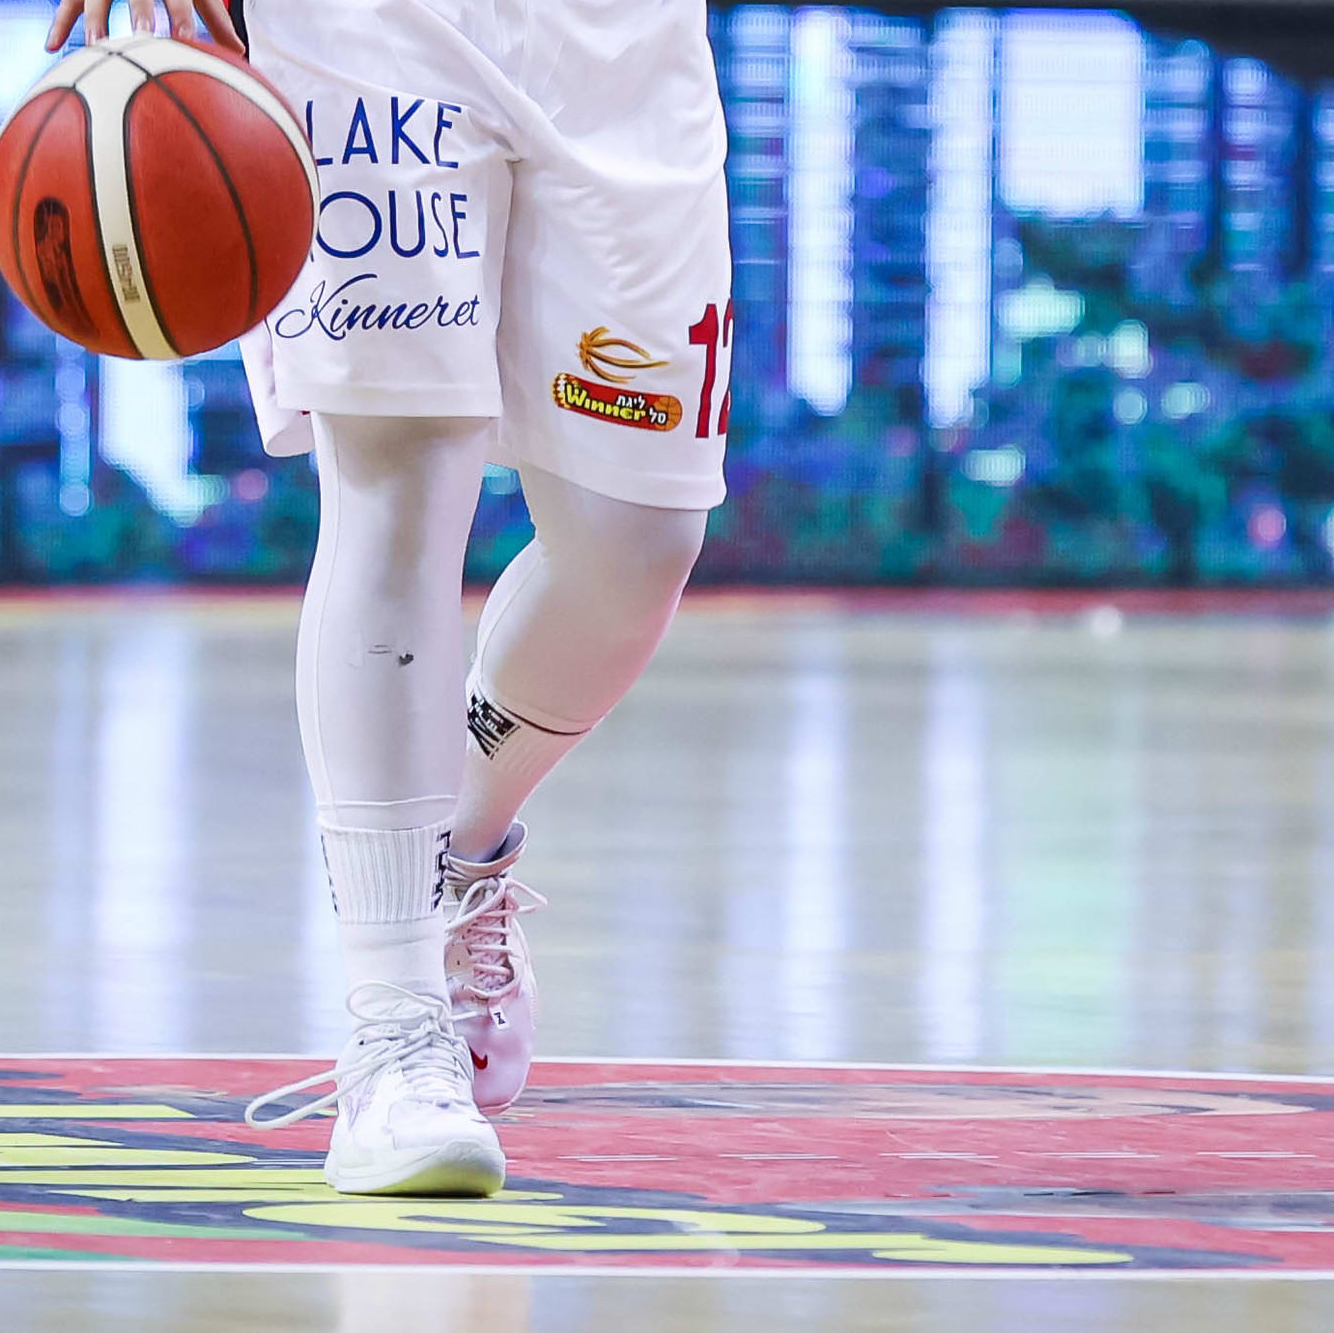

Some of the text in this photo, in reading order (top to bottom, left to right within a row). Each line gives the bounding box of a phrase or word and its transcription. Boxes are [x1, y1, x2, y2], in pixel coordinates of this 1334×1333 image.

[306, 96, 463, 169] LAKE
[310, 188, 481, 260] OUSE
[275, 272, 481, 341] Kinneret
[565, 383, 646, 422] Winner
[616, 394, 646, 409] ליגת
